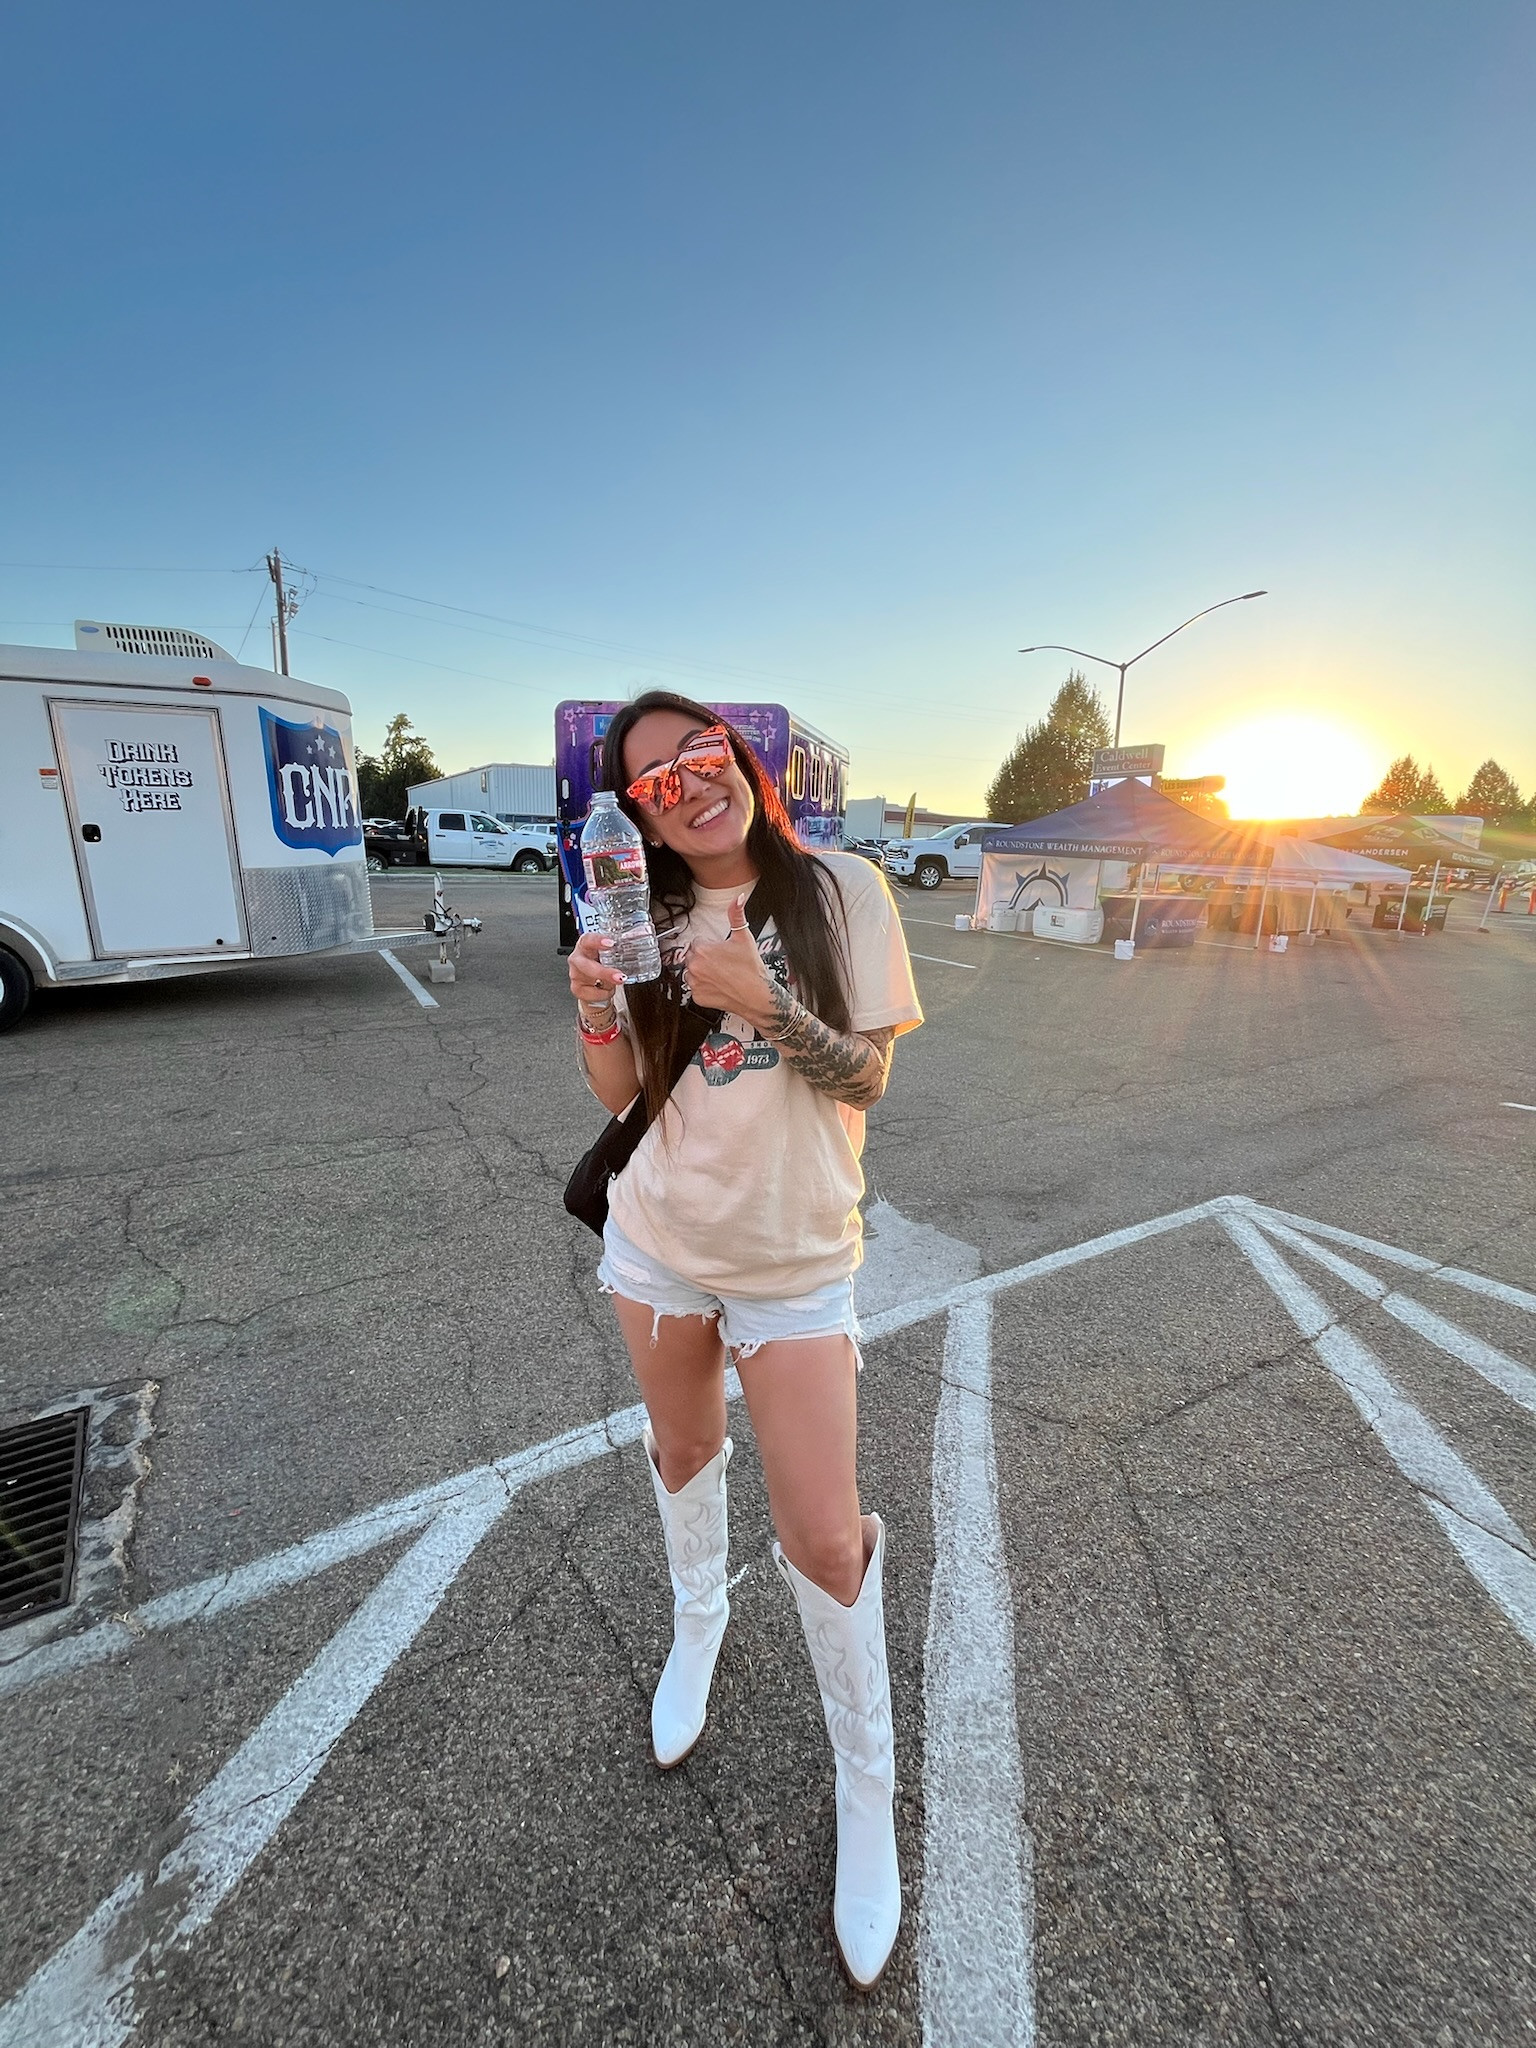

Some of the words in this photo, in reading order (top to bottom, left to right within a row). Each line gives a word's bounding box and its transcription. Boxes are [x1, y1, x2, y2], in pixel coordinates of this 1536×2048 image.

[104, 739, 179, 763] DRINK
[1100, 747, 1149, 763] Caldwell
[1095, 763, 1120, 773] Event
[1121, 761, 1152, 771] Center
[97, 764, 193, 788] TOKENS
[119, 789, 182, 812] HERE
[279, 762, 360, 830] CNR
[995, 839, 1044, 850] ROUNDSTONE
[1047, 842, 1080, 853] WEALTH
[1081, 844, 1144, 855] MANAGEMENT
[1359, 848, 1409, 857] ANDERSEN
[746, 1054, 770, 1065] 1973
